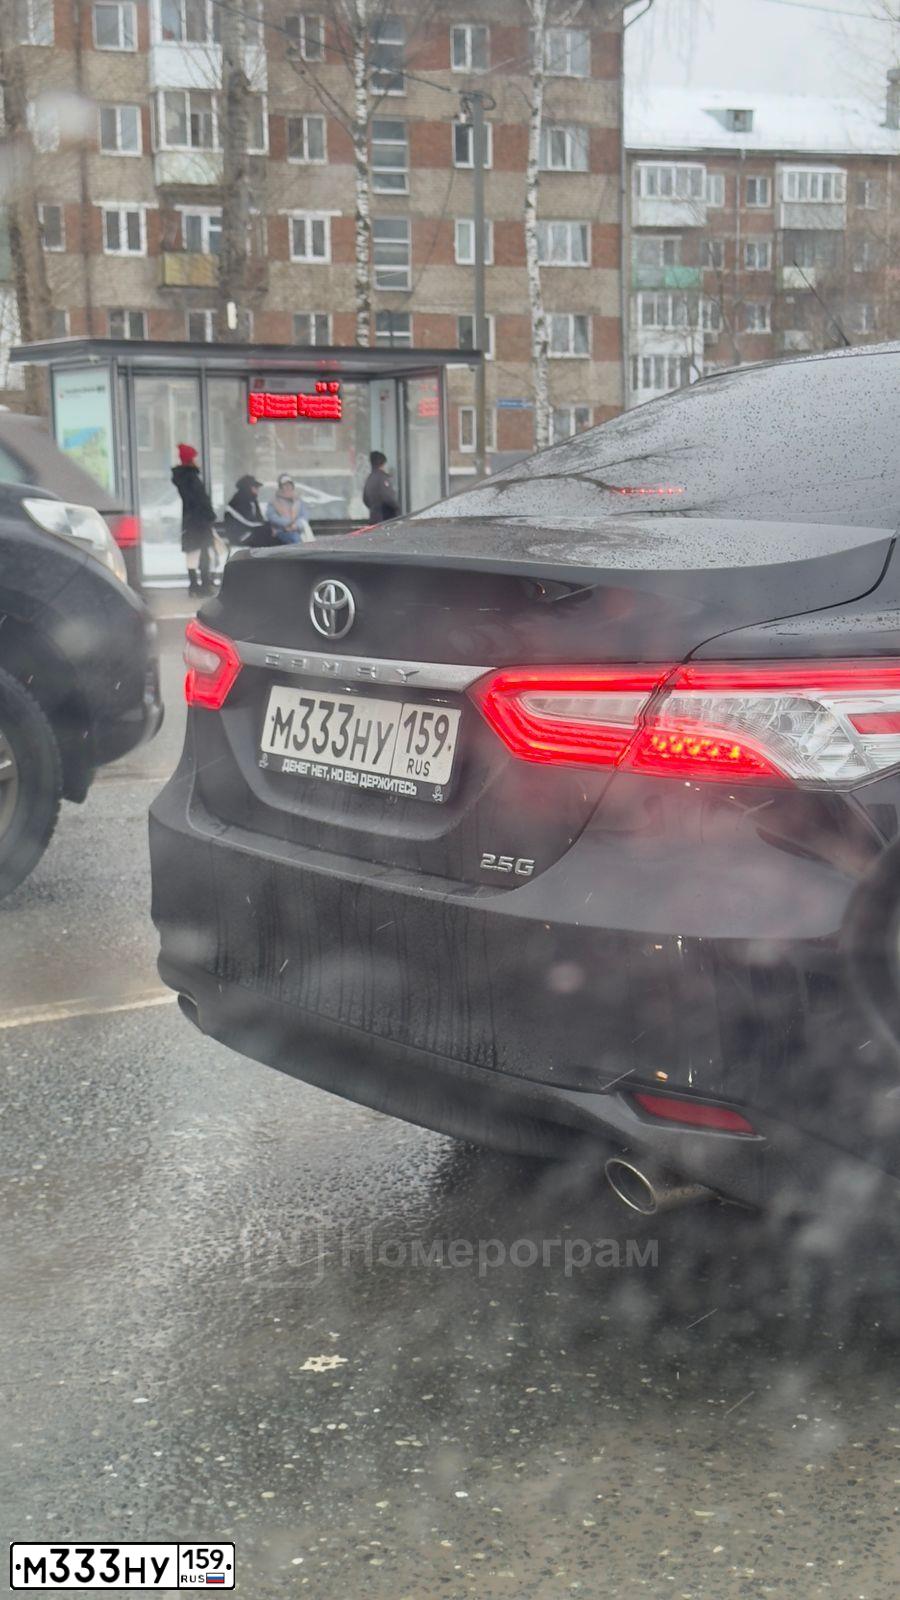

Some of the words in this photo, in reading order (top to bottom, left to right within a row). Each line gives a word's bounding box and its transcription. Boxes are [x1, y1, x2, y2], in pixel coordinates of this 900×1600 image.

[270, 697, 394, 765] М333НУ
[403, 710, 450, 758] 159
[281, 758, 311, 774] ДЕНЕГ
[311, 763, 331, 781] НЕТ,
[331, 768, 343, 781] НО
[344, 770, 359, 784] ВЫ
[359, 772, 418, 795] ДЕРЖИТЕСЬ
[406, 758, 431, 777] RUS
